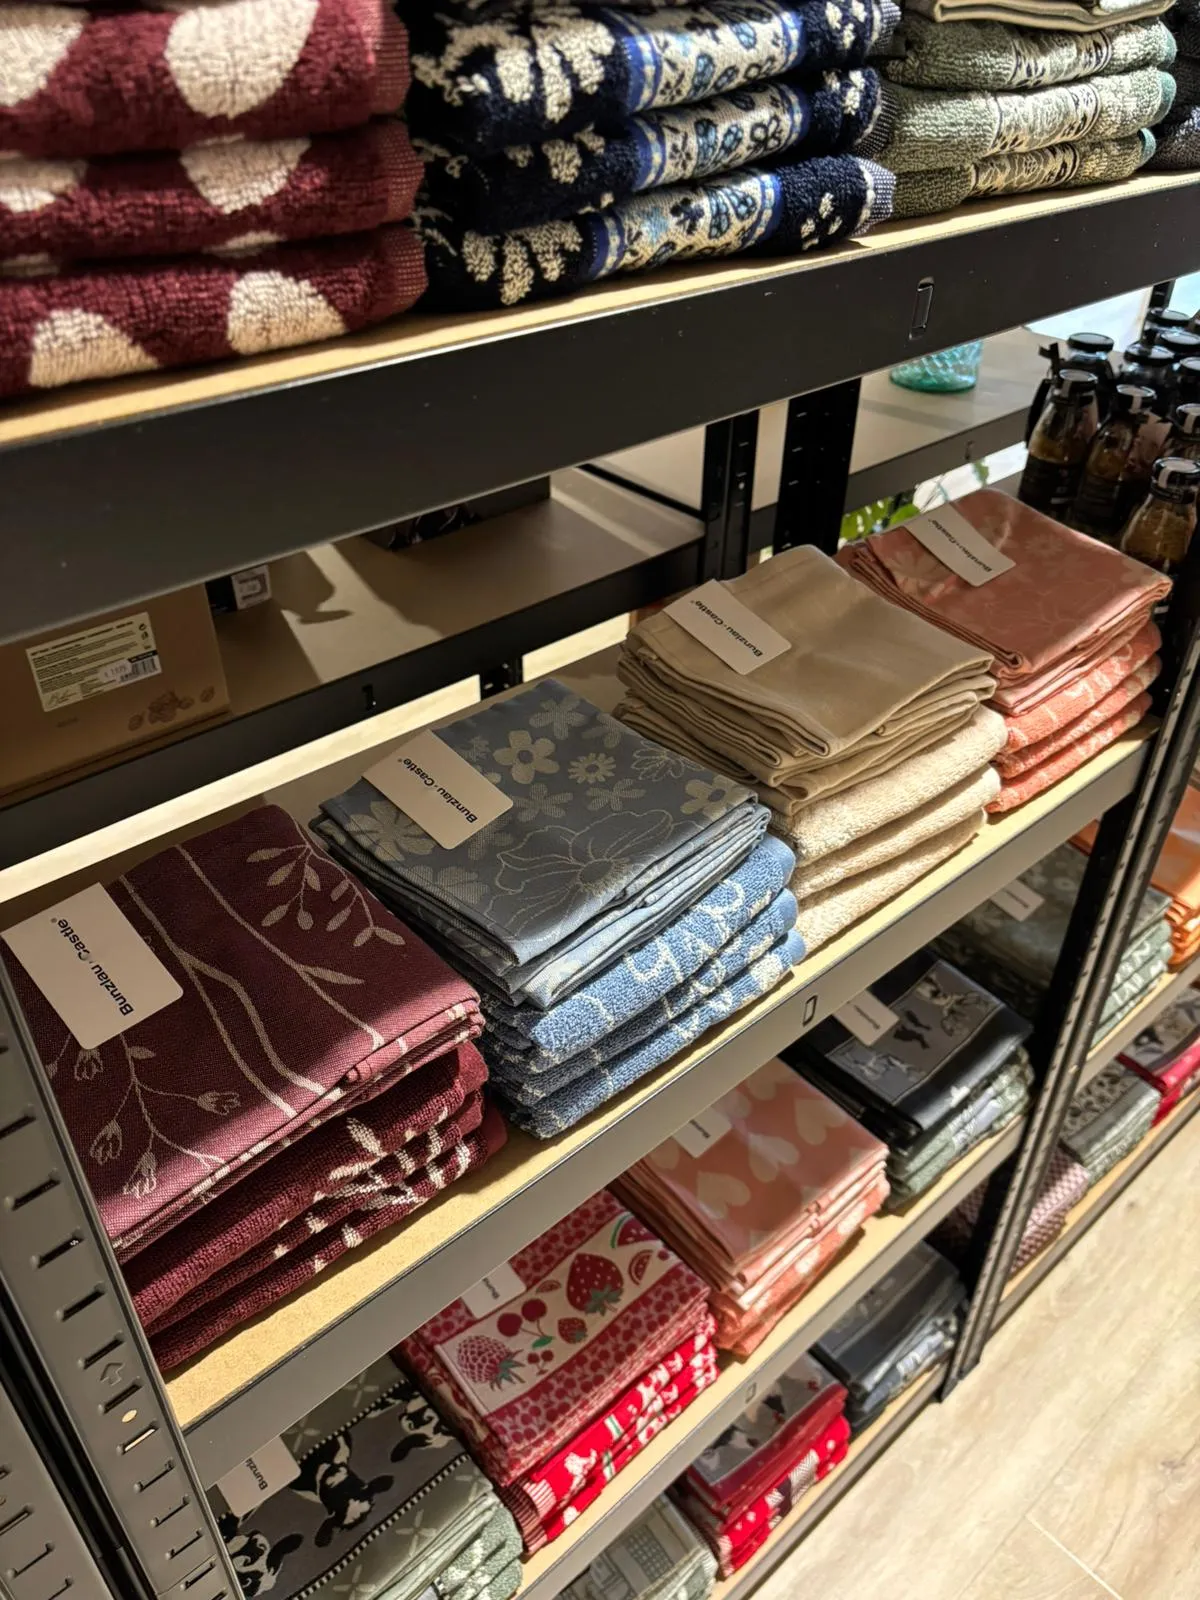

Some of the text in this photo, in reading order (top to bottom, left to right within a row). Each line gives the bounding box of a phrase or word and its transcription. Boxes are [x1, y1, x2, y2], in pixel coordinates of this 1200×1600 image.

[695, 600, 763, 657] Bunzlau Castle
[403, 758, 478, 823] Bunzlau Castle
[57, 918, 134, 1016] Bunzlau Castle
